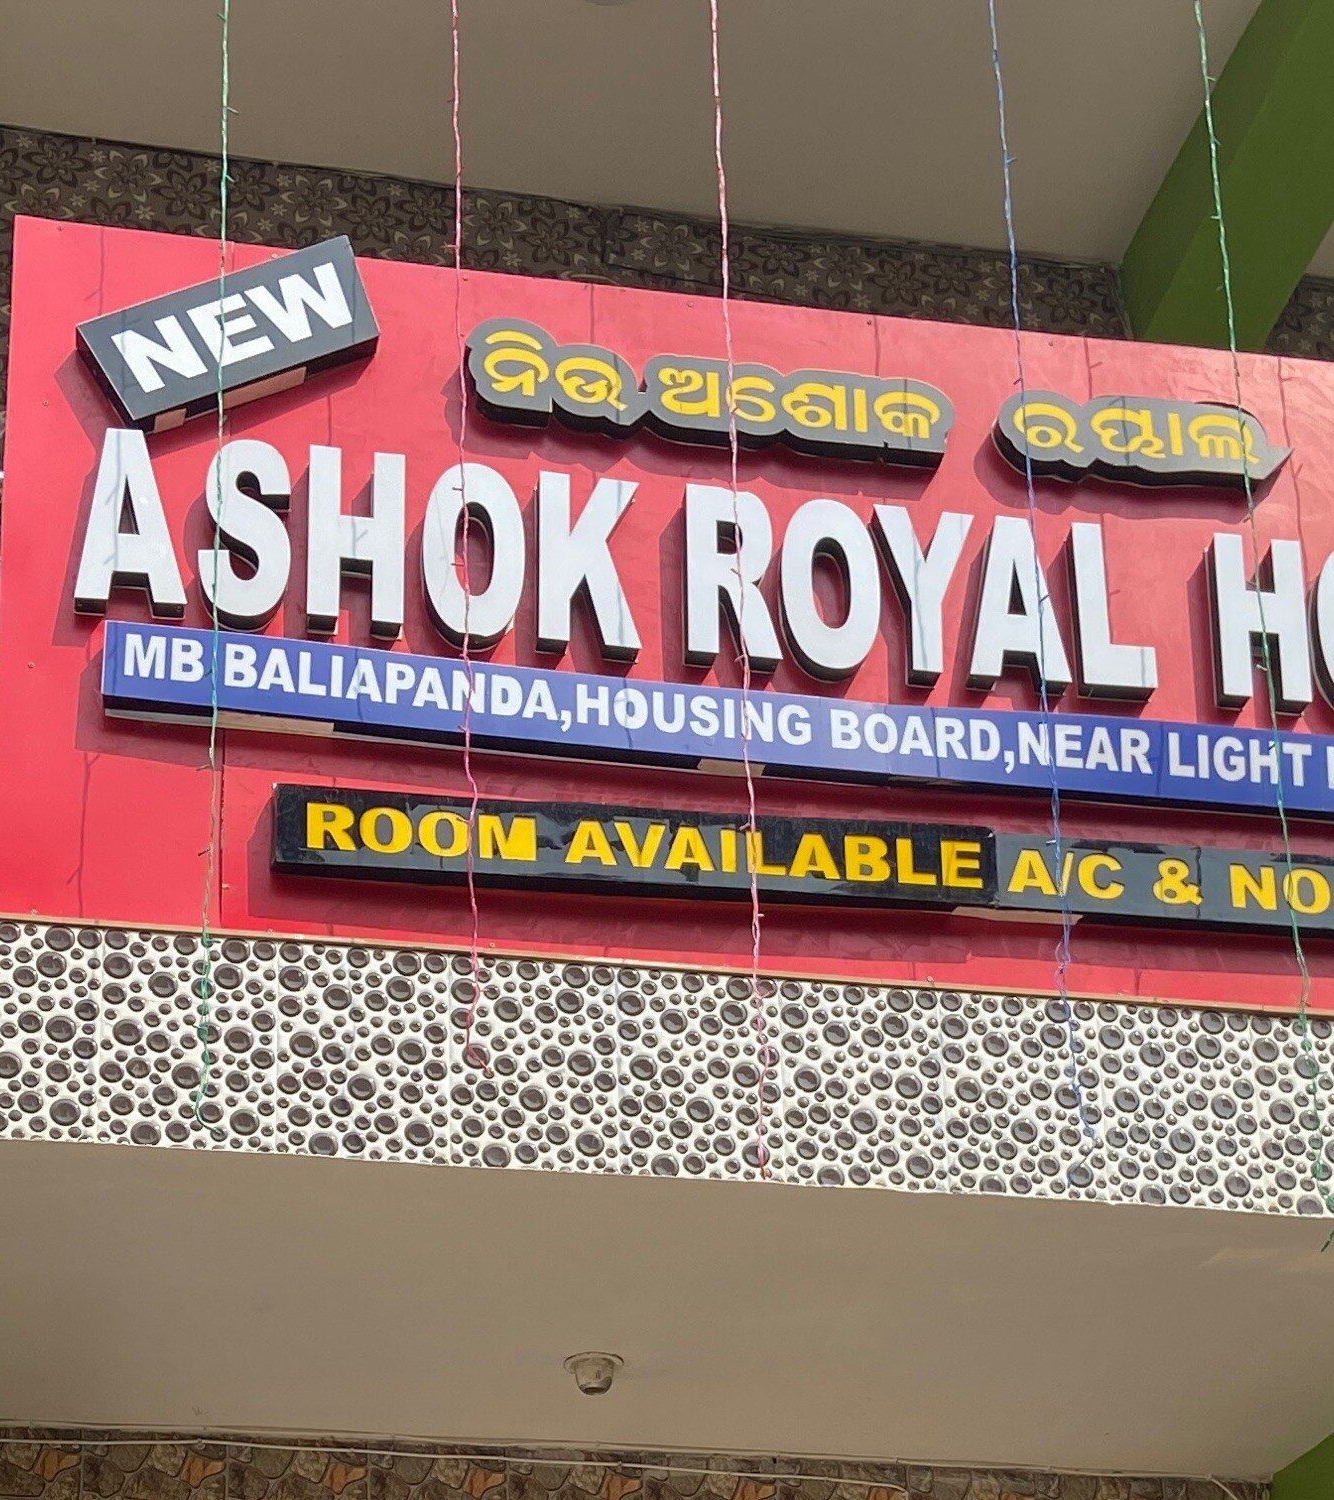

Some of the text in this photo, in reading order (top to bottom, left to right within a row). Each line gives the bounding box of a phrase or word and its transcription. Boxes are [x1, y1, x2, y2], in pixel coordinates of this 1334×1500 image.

[110, 261, 356, 393] NEW
[658, 367, 941, 439] ଅଶୋକ
[74, 427, 643, 662] ASHOK
[685, 482, 1157, 697] ROYAL
[123, 633, 204, 681] MB
[224, 643, 812, 746] BALIAPANDA,HOUSING
[831, 709, 1154, 776] BOARD,NEAR
[1168, 731, 1313, 787] LIGHT
[306, 802, 538, 862] ROOM
[564, 819, 984, 889] AVAILABLE
[1007, 848, 1125, 900] A/C
[1153, 858, 1204, 906] &
